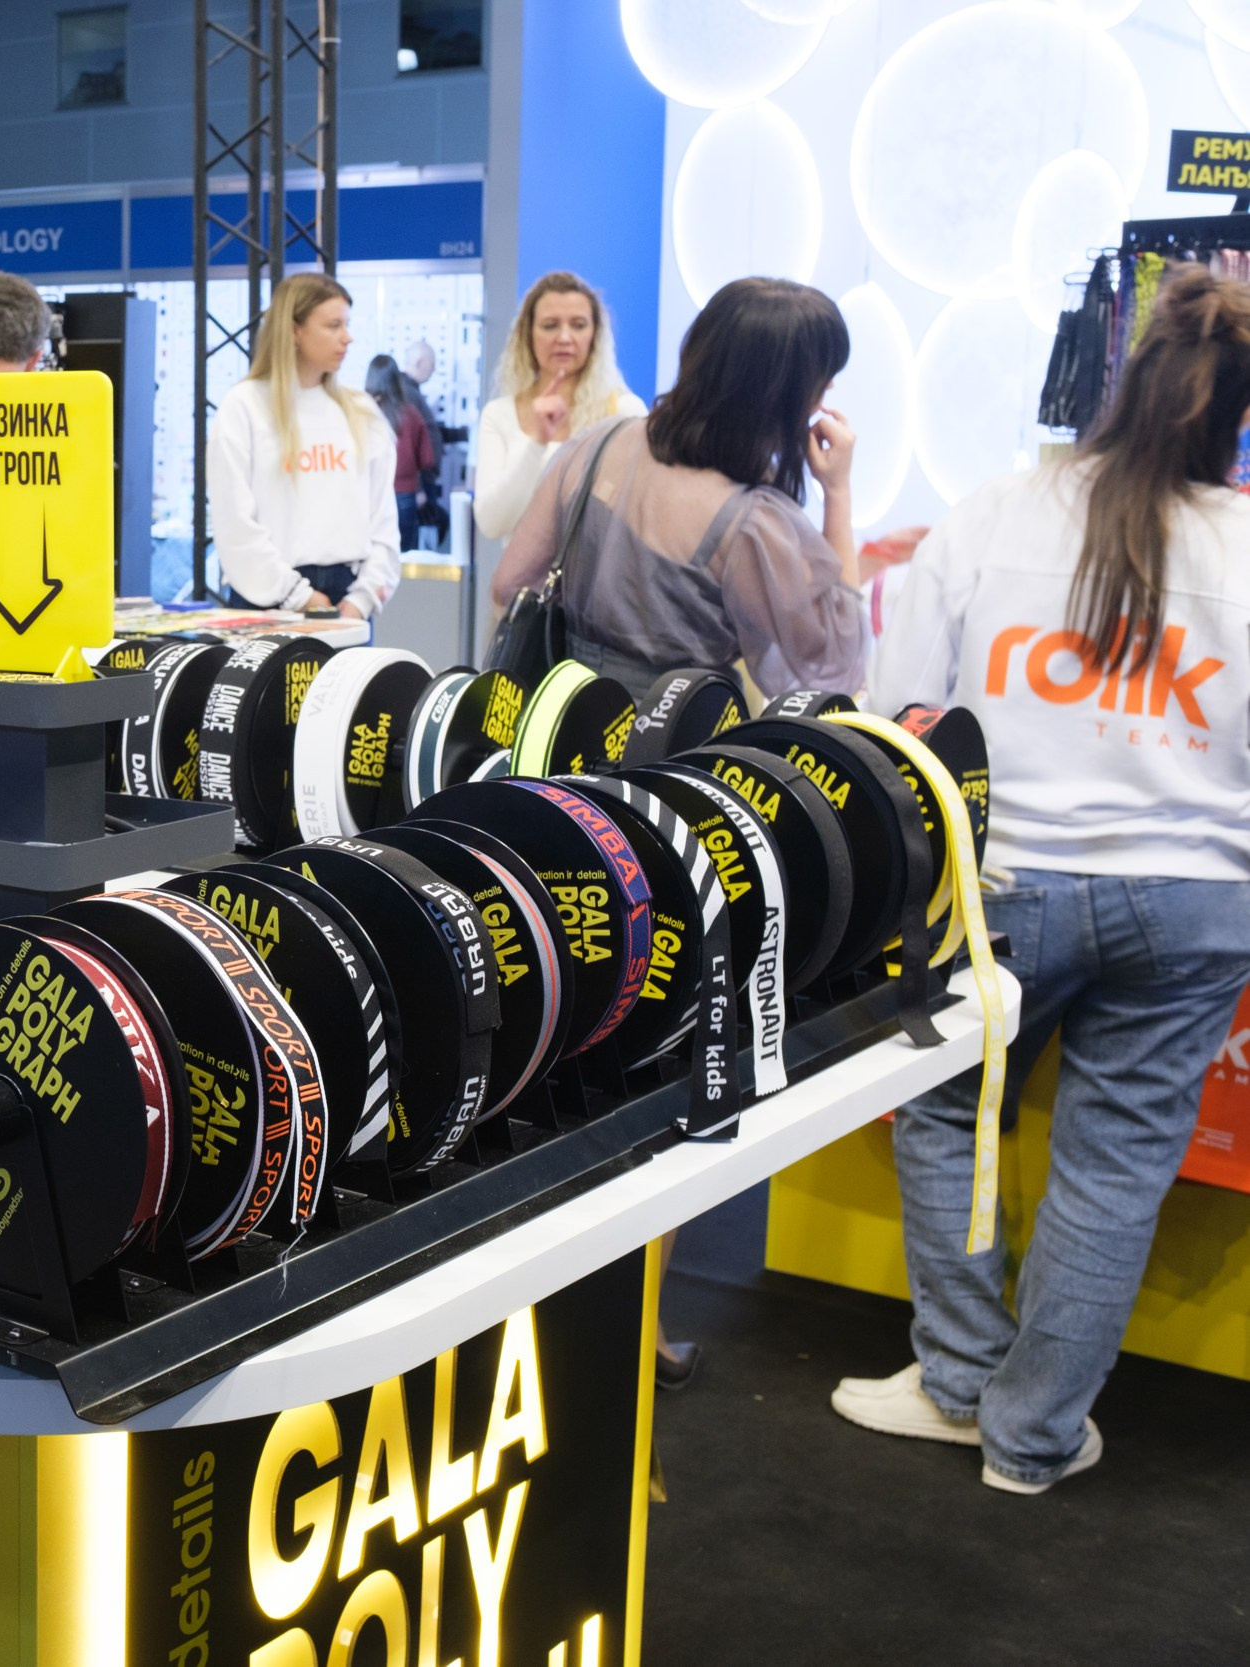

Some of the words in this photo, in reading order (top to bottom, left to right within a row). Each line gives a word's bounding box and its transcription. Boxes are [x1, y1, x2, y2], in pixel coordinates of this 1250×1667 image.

[498, 675, 523, 711] GALA
[985, 614, 1225, 731] rolik
[202, 684, 222, 730] RUSSIA
[210, 684, 245, 734] DANCE
[486, 716, 516, 749] GRAP
[492, 696, 520, 727] POLY
[348, 723, 367, 776] GALA
[360, 727, 378, 777] POLY
[371, 713, 392, 779] GRAPH
[1096, 722, 1209, 753] TEAM
[208, 752, 234, 802] DANCE
[722, 766, 780, 822] GALA
[796, 752, 851, 809] GALA
[537, 788, 640, 885] SIMBA
[698, 814, 724, 831] details
[577, 869, 607, 880] details
[706, 829, 752, 903] GALA
[155, 897, 238, 956] SPORT
[210, 885, 280, 944] GALA
[580, 885, 612, 964] GALA
[657, 911, 686, 931] details
[4, 971, 13, 988] in
[11, 939, 32, 974] details
[481, 902, 529, 987] GALA
[640, 929, 682, 1001] GALA
[712, 955, 725, 986] LT
[25, 955, 95, 1045] GALA
[756, 906, 779, 1061] ASTRONAUT
[5, 982, 78, 1066] POLY
[237, 983, 315, 1078] SPORT
[709, 995, 727, 1035] for
[706, 1045, 727, 1101] kids
[236, 1149, 282, 1237] SPORT
[297, 1114, 323, 1220] SPORT
[248, 1304, 548, 1620] GALA
[168, 1450, 216, 1667] details
